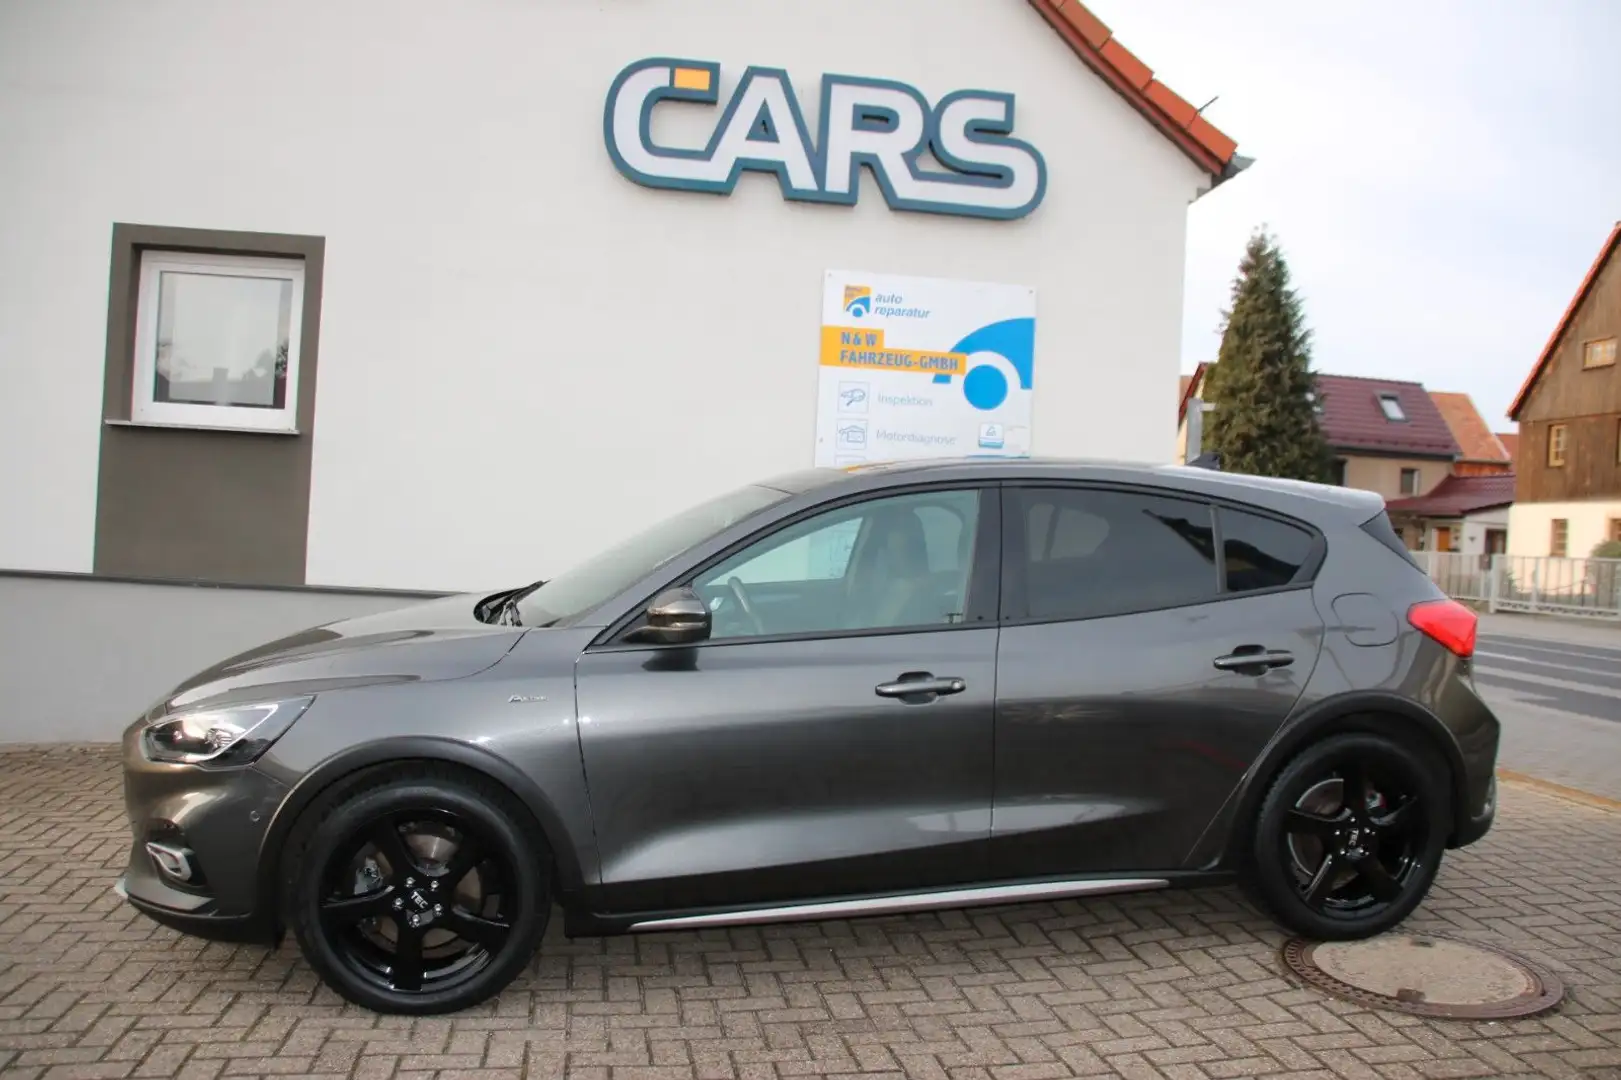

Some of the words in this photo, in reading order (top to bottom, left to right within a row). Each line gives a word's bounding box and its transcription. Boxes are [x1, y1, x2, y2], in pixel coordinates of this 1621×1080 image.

[604, 58, 1047, 219] CARS
[875, 293, 903, 305] auto
[874, 306, 931, 319] reparatur
[841, 331, 851, 345] N
[853, 332, 862, 346] &
[865, 333, 877, 347] W
[839, 349, 959, 371] FAHRZEUG-GMBH
[877, 393, 934, 407] Inspektion
[876, 429, 957, 446] Motordiagnose
